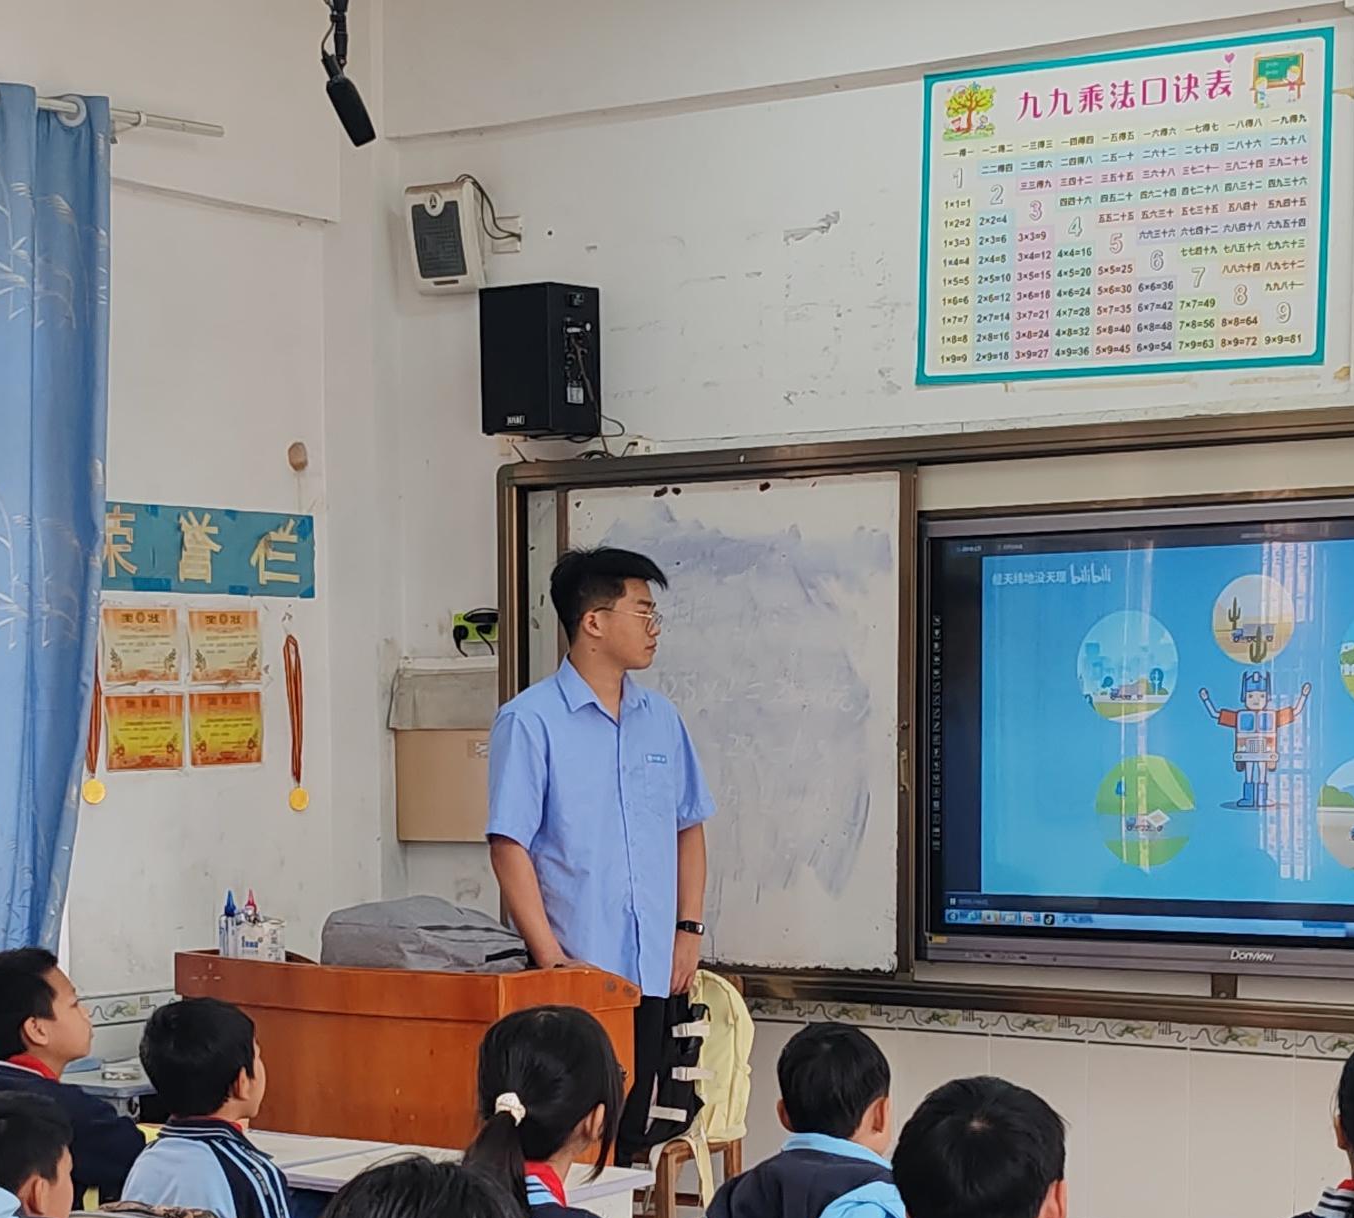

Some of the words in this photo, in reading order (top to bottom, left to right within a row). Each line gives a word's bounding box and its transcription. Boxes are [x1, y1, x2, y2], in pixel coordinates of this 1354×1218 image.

[1017, 69, 1232, 121] 九九乘法口诀表
[944, 149, 973, 157] 一一得一
[982, 144, 1013, 153] 一二得二
[1022, 140, 1053, 150] 一三得三
[1061, 136, 1094, 145] 一四得四
[1102, 131, 1134, 141] 一五得五
[1143, 127, 1176, 137] 一六得六
[1185, 123, 1219, 133] 一七得七
[1227, 118, 1262, 129] 一八得八
[1271, 114, 1307, 125] 一九得九
[982, 163, 1013, 174] 二二得四
[1021, 160, 1053, 170] 二三得六
[1061, 157, 1093, 166] 二四得八
[1101, 152, 1133, 162] 二五一十
[1143, 148, 1176, 158] 二六十二
[1185, 143, 1219, 154] 二七十四
[1227, 139, 1261, 150] 二八十六
[1270, 135, 1306, 146] 二九十八
[953, 168, 963, 188] 1
[1020, 180, 1051, 190] 三三得九
[1060, 176, 1093, 186] 三四十二
[1101, 172, 1133, 183] 三五十五
[1143, 168, 1175, 179] 三六十八
[1183, 164, 1220, 175] 三七二十一
[1225, 159, 1263, 171] 三八二十四
[1268, 155, 1308, 167] 三九二十七
[990, 184, 1004, 205] 2
[1060, 196, 1092, 206] 四四十六
[1101, 192, 1133, 202] 四五二十
[1140, 188, 1177, 199] 四六二十四
[1182, 184, 1219, 195] 四七二十八
[1225, 181, 1263, 192] 四八三十二
[1268, 177, 1307, 188] 四九三十六
[945, 199, 971, 208] 1×1=1
[1029, 200, 1042, 221] 3
[1098, 211, 1134, 223] 五五二十五
[1141, 208, 1174, 219] 五六三十
[1181, 204, 1219, 216] 五七三十五
[1228, 201, 1258, 212] 五八四十
[1268, 197, 1307, 209] 五九四十五
[944, 219, 971, 228] 1×2=2
[979, 215, 1007, 225] 2×2=4
[1068, 216, 1082, 237] 4
[1139, 228, 1176, 239] 六六三十六
[1180, 225, 1219, 236] 六七四十二
[1223, 221, 1261, 233] 六八四十八
[1267, 218, 1306, 230] 六九五十四
[944, 237, 970, 247] 1×3=3
[979, 235, 1007, 245] 2×3=6
[1018, 231, 1046, 242] 3×3=9
[1109, 232, 1123, 254] 5
[1181, 246, 1218, 256] 七七四十九
[1223, 242, 1261, 253] 七八五十六
[1266, 239, 1305, 250] 七九六十三
[943, 257, 969, 267] 1×4=4
[978, 254, 1006, 264] 2×4=8
[1017, 251, 1051, 262] 3×4=12
[1057, 248, 1092, 258] 4×4=16
[1150, 250, 1163, 271] 6
[1222, 263, 1260, 273] 八八六十四
[1265, 260, 1305, 272] 八九七十二
[943, 276, 969, 286] 1×5=5
[977, 274, 1011, 284] 2×5=10
[1017, 270, 1051, 281] 3×5=15
[1057, 267, 1091, 278] 4×5=20
[1098, 264, 1133, 274] 5×5=25
[1192, 267, 1205, 288] 7
[943, 296, 969, 306] 1×6=6
[977, 293, 1010, 304] 2×6=12
[1016, 290, 1050, 300] 3×6=18
[1057, 287, 1091, 297] 4×6=24
[1097, 284, 1132, 295] 5×6=30
[1138, 281, 1173, 292] 6×6=36
[1234, 284, 1248, 305] 8
[1265, 281, 1304, 291] 九九八十一
[942, 315, 968, 324] 1×7=7
[977, 313, 1010, 323] 2×7=14
[1016, 310, 1049, 320] 3×7=21
[1056, 307, 1090, 317] 4×7=28
[1097, 304, 1131, 315] 5×7=35
[1137, 301, 1173, 312] 6×7=42
[1179, 298, 1215, 309] 7×7=49
[1276, 302, 1291, 323] 9
[941, 334, 968, 344] 1×8=8
[976, 332, 1009, 342] 2×8=16
[1015, 329, 1049, 340] 3×8=24
[1055, 327, 1090, 337] 4×8=32
[1096, 324, 1131, 334] 5×8=40
[1137, 321, 1172, 332] 6×8=48
[1179, 318, 1215, 329] 7×8=56
[1221, 316, 1257, 327] 8×8=64
[941, 353, 967, 363] 1×9=9
[976, 351, 1009, 361] 2×9=18
[1015, 349, 1048, 359] 3×9=27
[1055, 346, 1089, 356] 4×9=36
[1096, 344, 1130, 355] 5×9=45
[1137, 341, 1172, 352] 6×9=54
[1179, 339, 1214, 349] 7×9=63
[1221, 336, 1257, 348] 8×9=72
[1265, 334, 1302, 345] 9×9=81
